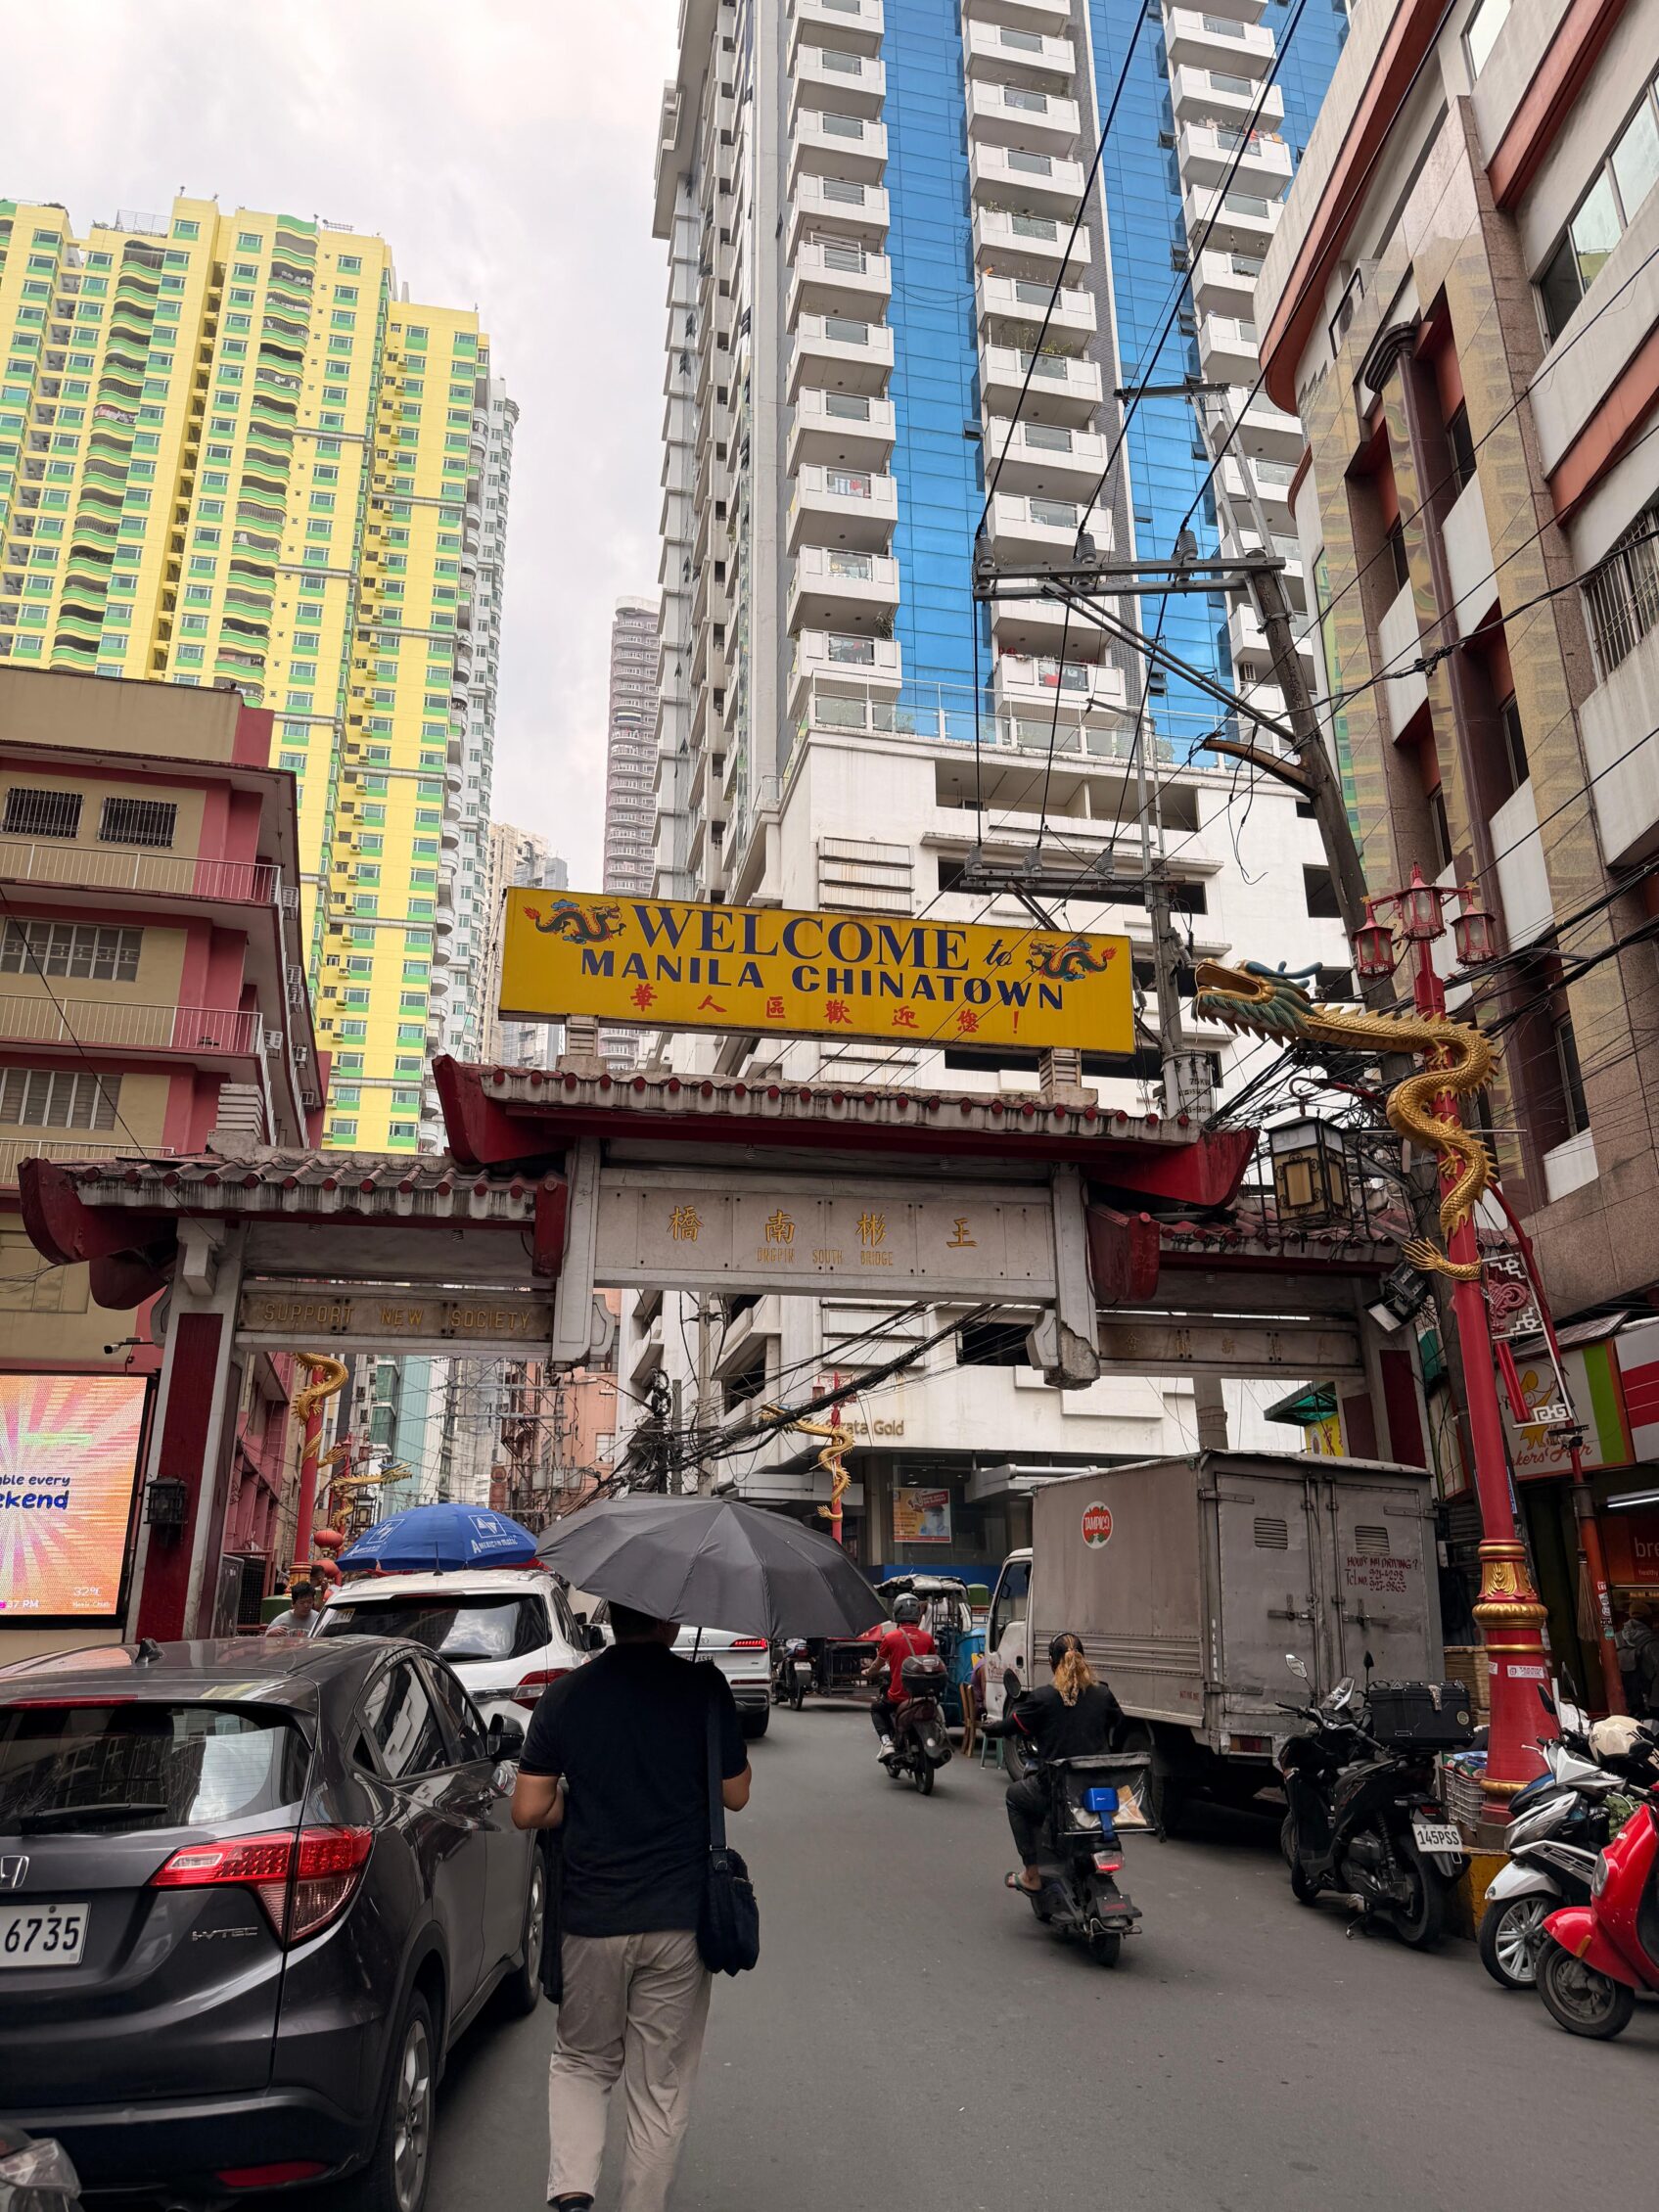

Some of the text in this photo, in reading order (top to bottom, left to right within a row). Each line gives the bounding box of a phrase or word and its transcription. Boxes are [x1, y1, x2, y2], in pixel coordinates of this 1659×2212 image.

[631, 904, 1013, 971] WELCOME to
[580, 947, 1063, 1010] MANILA CHINATOWN
[757, 1247, 894, 1266] ONGPIN SOUTH BRIDGE
[263, 1303, 530, 1330] SUPPORT NEW SOCIETY
[874, 1419, 904, 1436] Gold
[28, 1476, 70, 1487] every
[23, 1599, 39, 1609] PM
[1417, 1830, 1459, 1845] 145PSS
[4, 1916, 81, 1953] 6735
